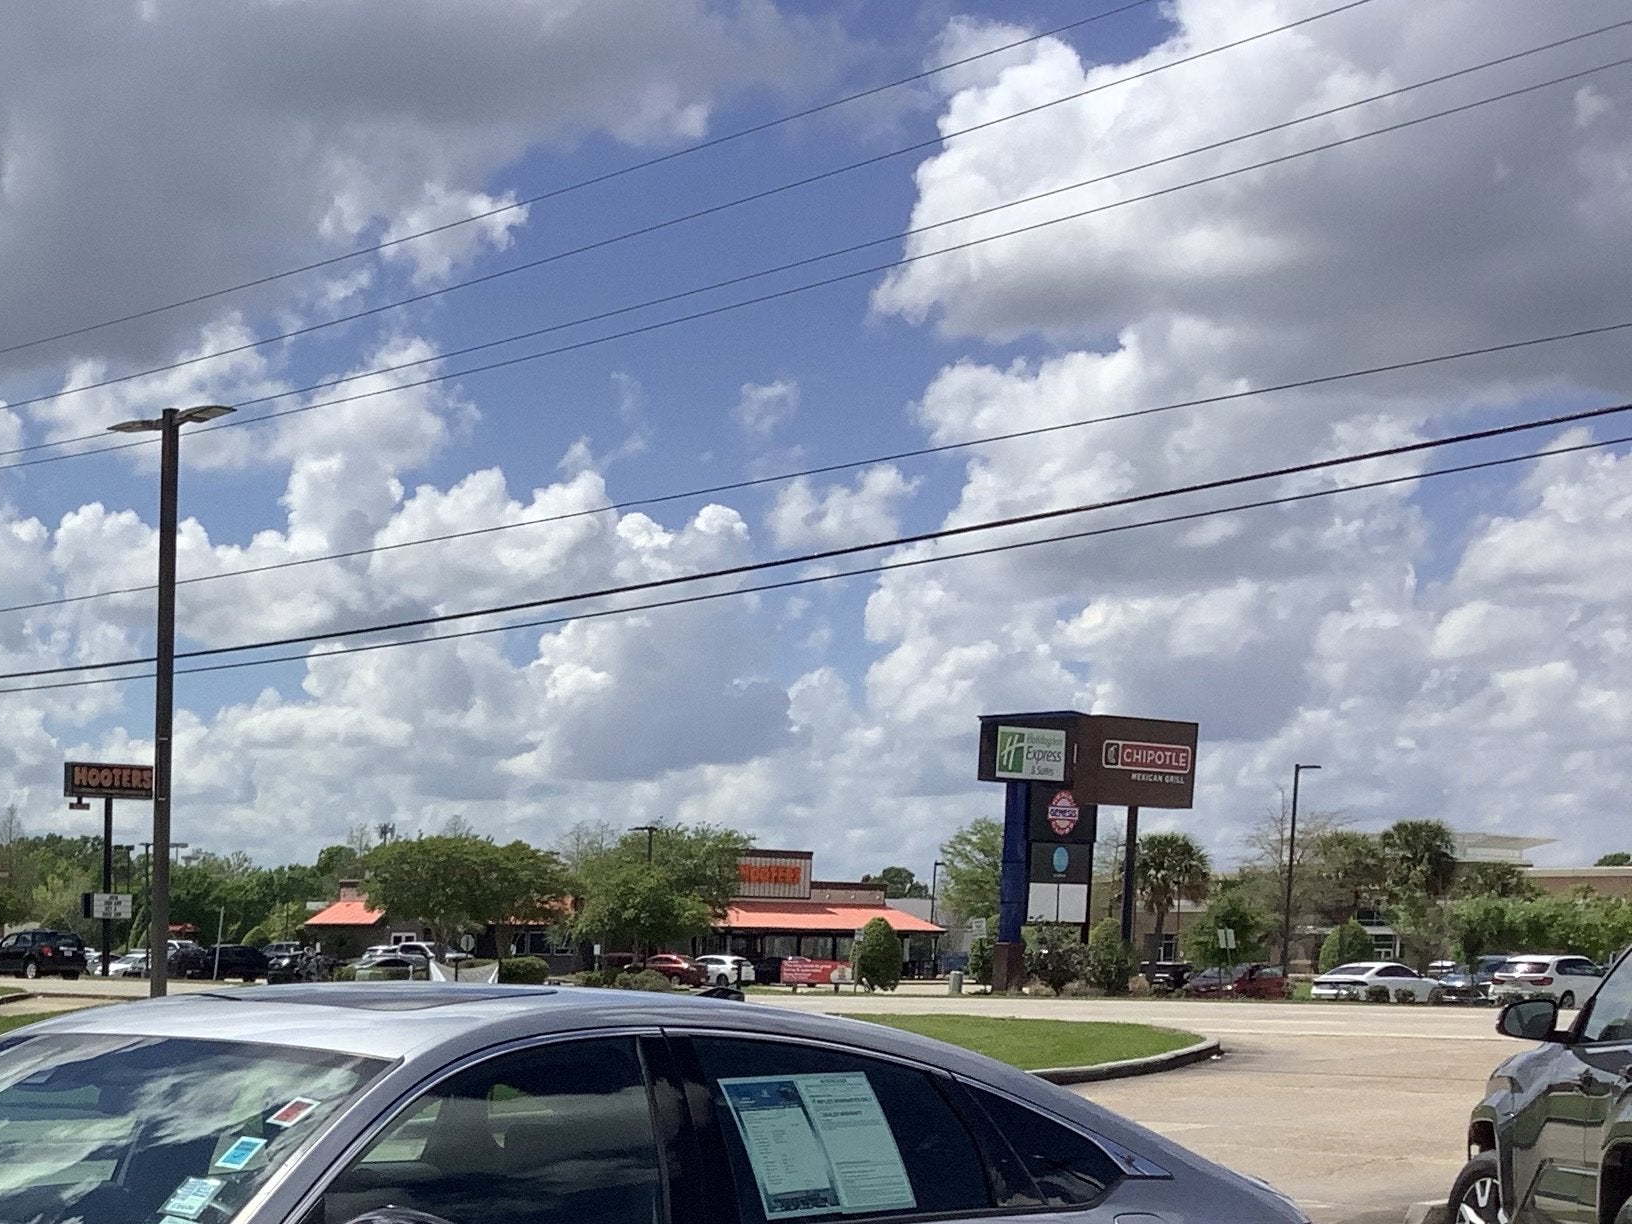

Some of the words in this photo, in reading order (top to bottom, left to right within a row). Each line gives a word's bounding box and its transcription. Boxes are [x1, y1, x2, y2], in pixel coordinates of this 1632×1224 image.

[1026, 746, 1062, 765] Express
[1123, 748, 1187, 767] CHIPOTLE
[74, 766, 153, 789] HOOTERS
[1131, 773, 1163, 782] MEXICAN
[1165, 775, 1184, 784] GRILL
[1049, 808, 1077, 817] GENESIS
